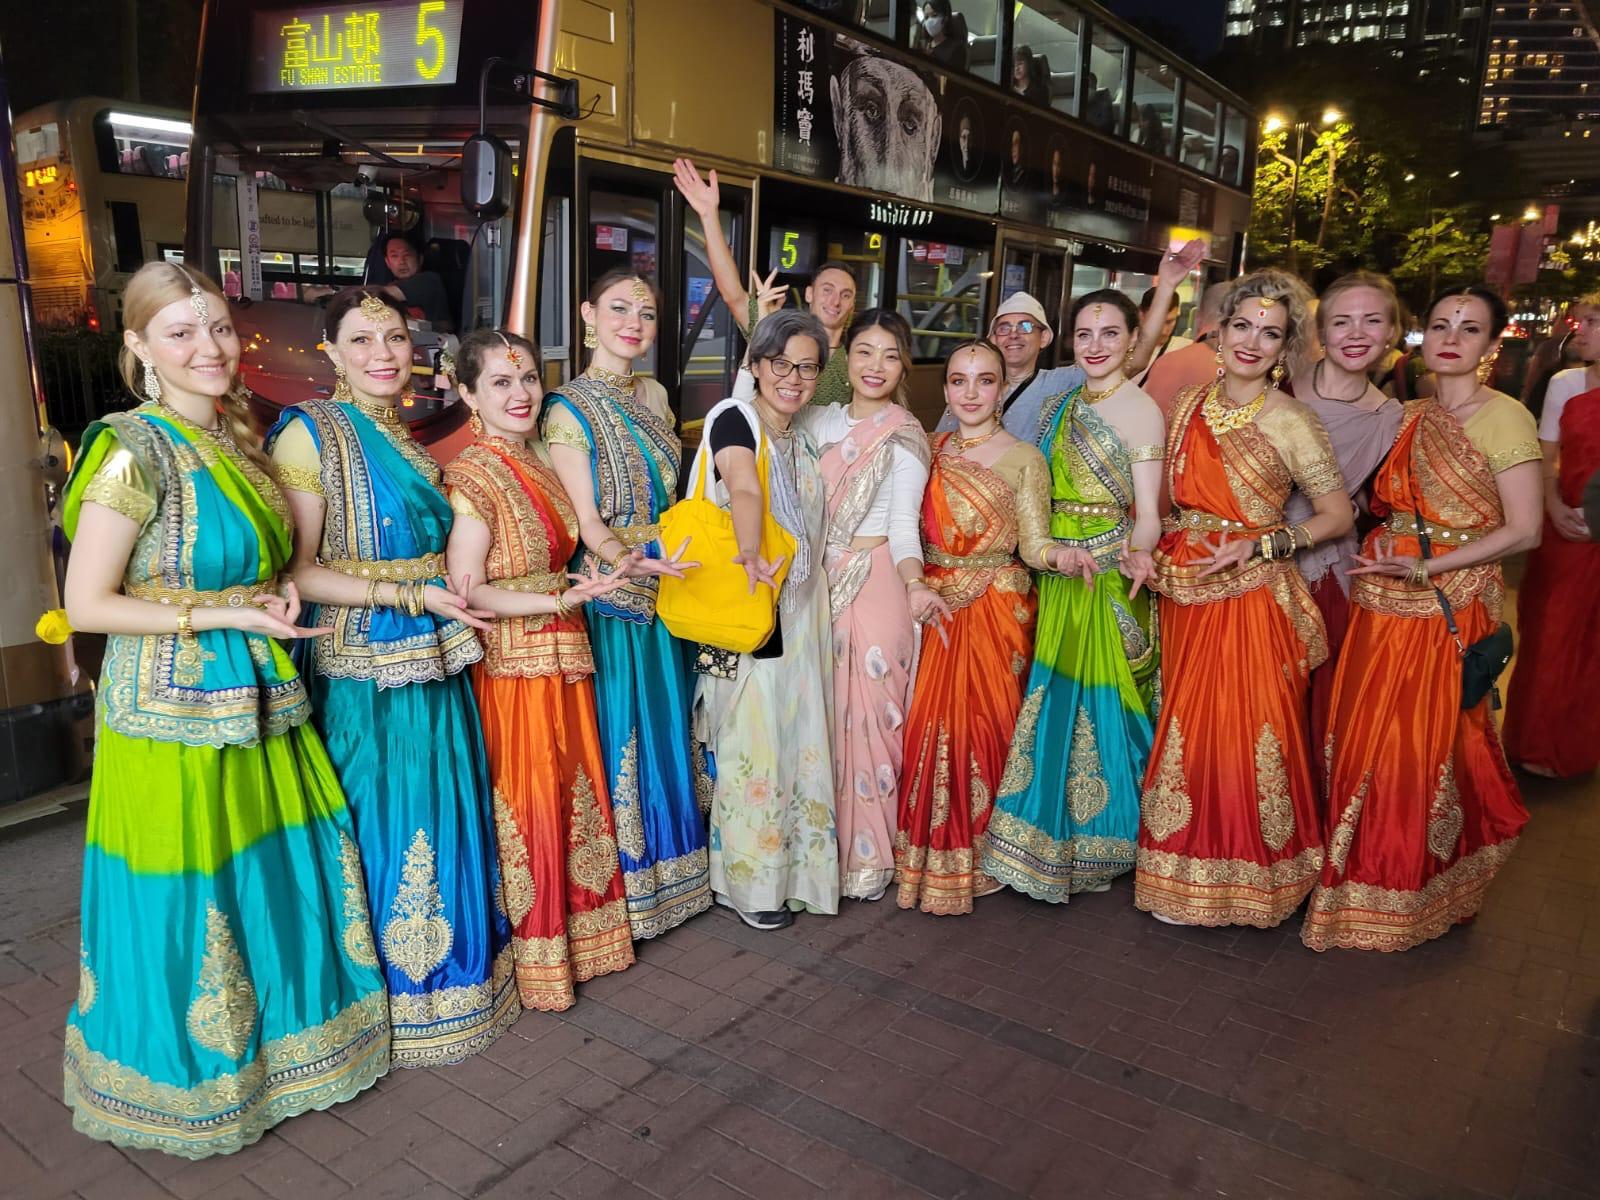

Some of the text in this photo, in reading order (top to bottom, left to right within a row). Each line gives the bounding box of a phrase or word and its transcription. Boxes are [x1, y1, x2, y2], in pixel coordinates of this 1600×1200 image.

[280, 12, 380, 67] 富山邨
[416, 1, 446, 80] 5
[280, 64, 381, 86] FU SHAN ESTATE
[780, 232, 800, 269] 5
